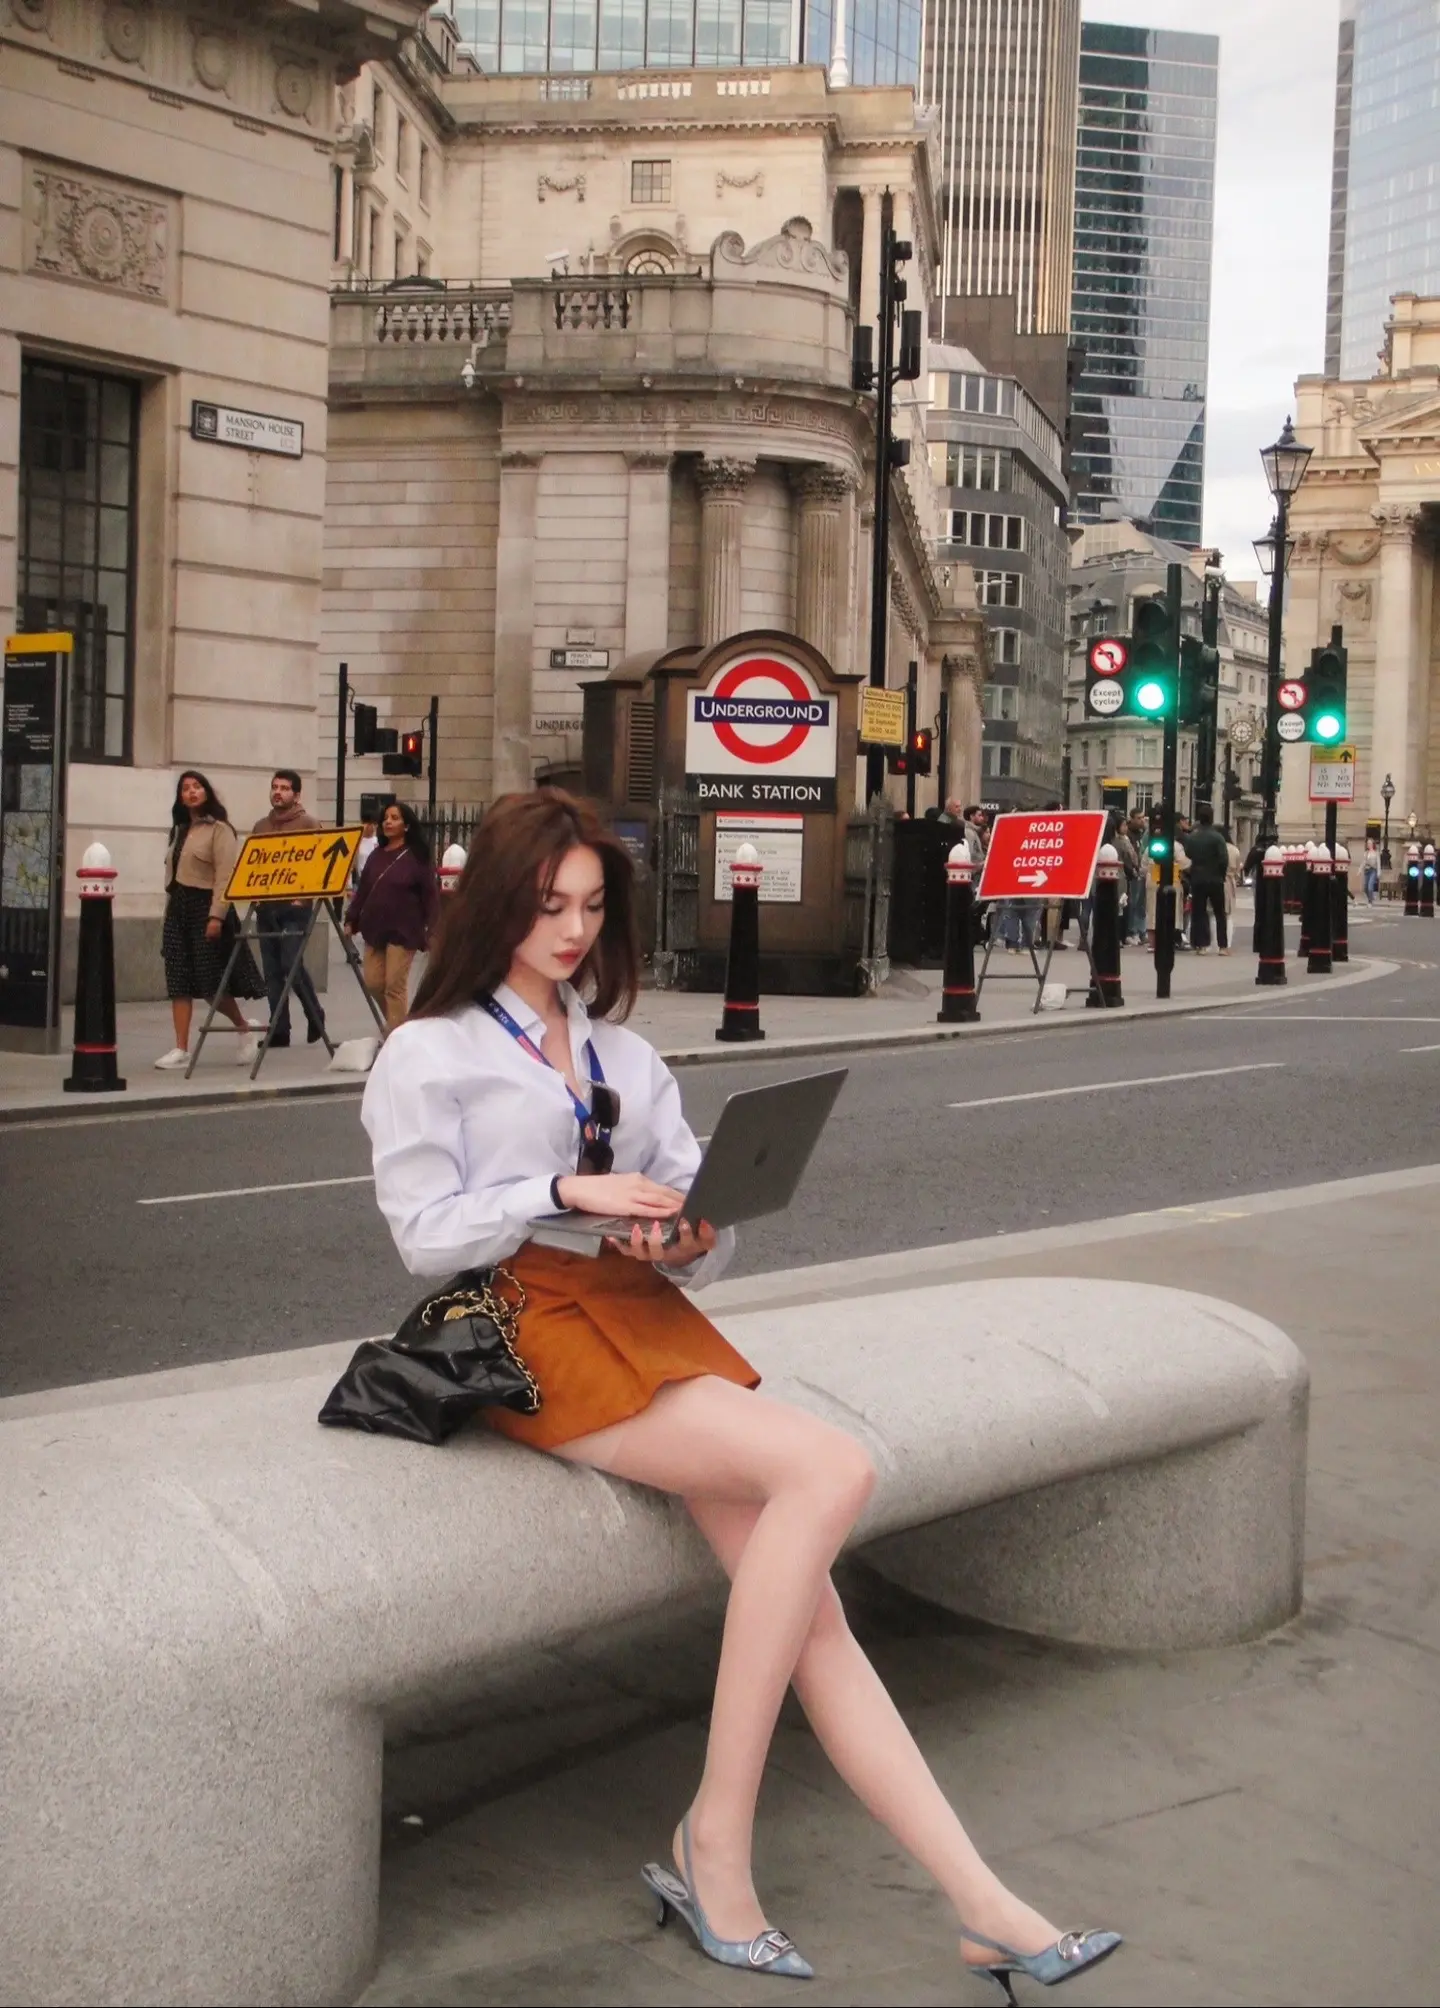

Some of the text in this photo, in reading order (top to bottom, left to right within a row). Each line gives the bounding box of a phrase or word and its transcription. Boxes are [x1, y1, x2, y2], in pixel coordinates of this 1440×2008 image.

[225, 415, 295, 437] MANSION HOUSE
[225, 427, 254, 441] STREET
[1093, 689, 1121, 697] Except
[700, 701, 823, 722] UNDERGROUND
[536, 719, 584, 731] UNDERG
[699, 783, 822, 801] BANK STATION
[1029, 821, 1064, 833] ROAD
[1020, 839, 1064, 850] AHEAD
[246, 844, 317, 865] Diverted
[1013, 855, 1063, 868] CLOSED
[246, 867, 298, 887] traffic
